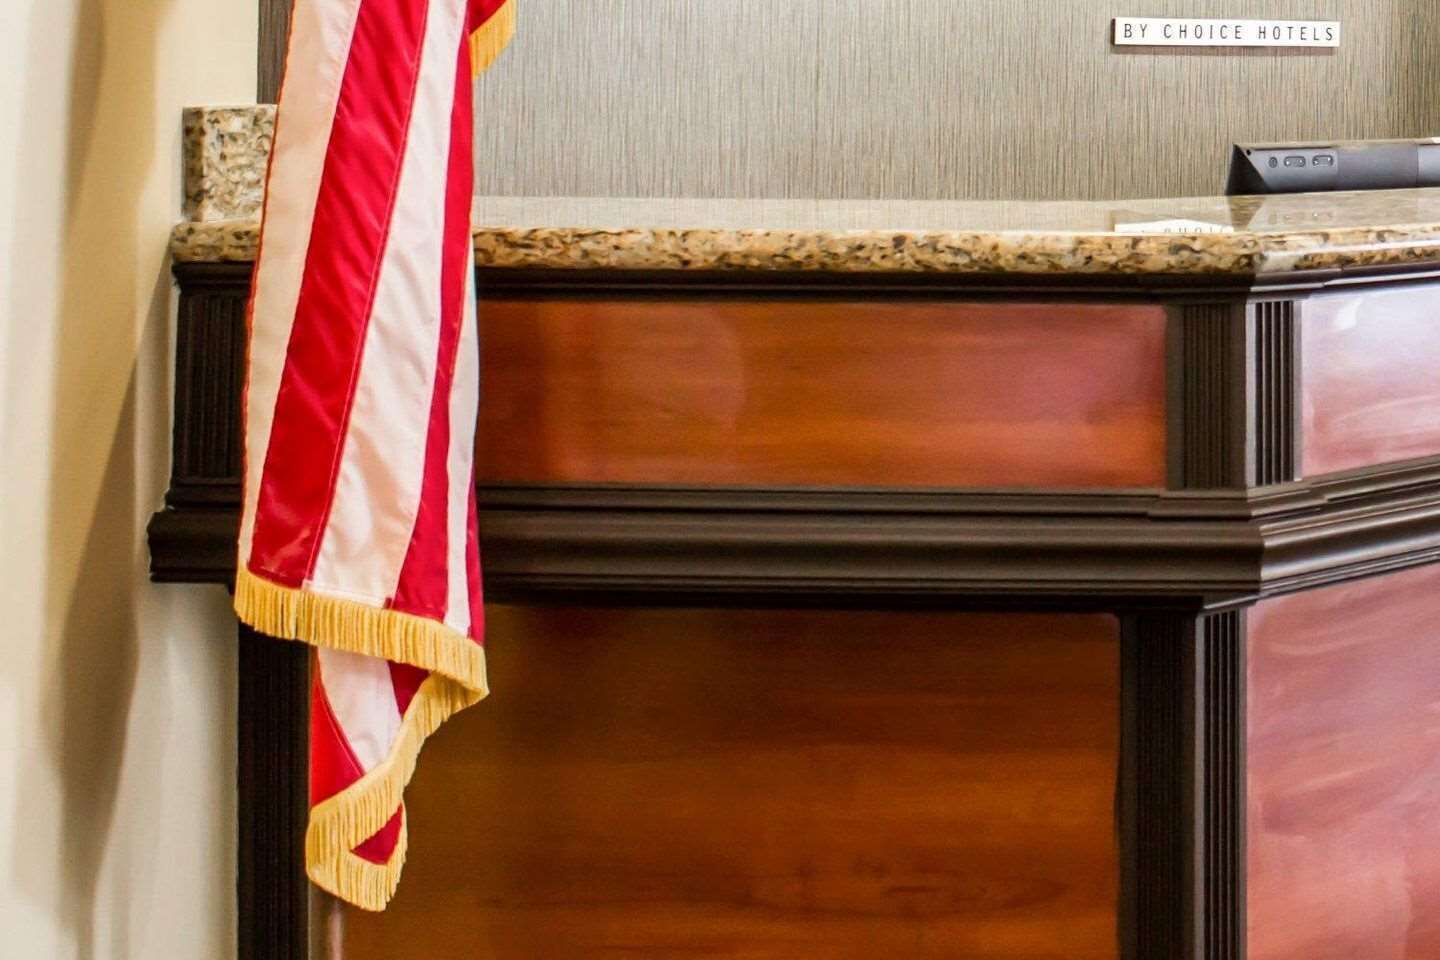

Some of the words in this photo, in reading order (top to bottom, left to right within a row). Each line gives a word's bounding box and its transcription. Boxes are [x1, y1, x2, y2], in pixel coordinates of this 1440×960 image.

[1123, 23, 1148, 38] BY
[1163, 23, 1243, 40] CHOICE
[1258, 25, 1335, 41] HOTELS
